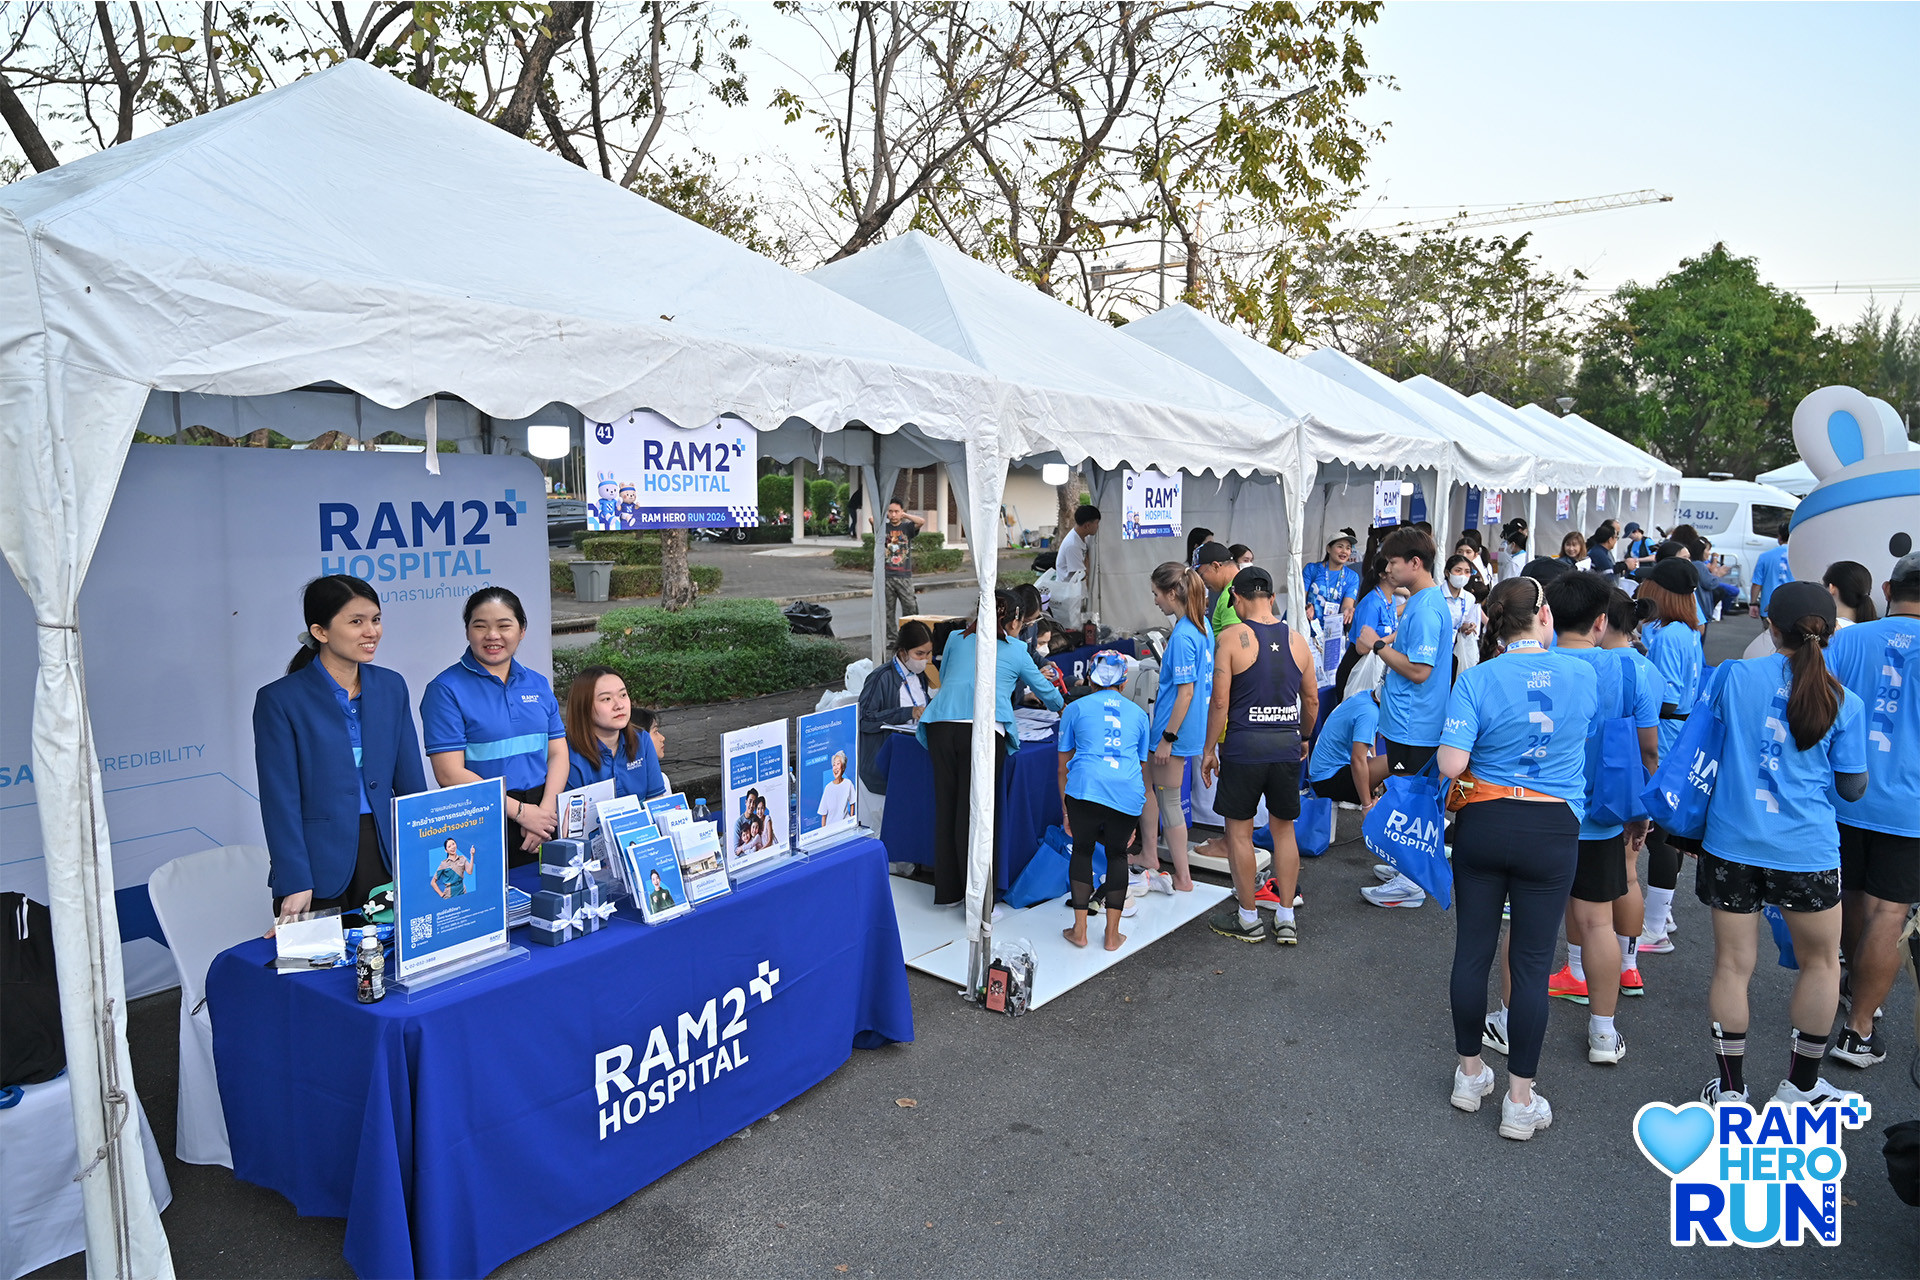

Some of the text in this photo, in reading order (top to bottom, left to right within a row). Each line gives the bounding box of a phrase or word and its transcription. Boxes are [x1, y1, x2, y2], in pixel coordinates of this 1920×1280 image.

[597, 426, 612, 438] 41
[643, 439, 730, 472] RAM2
[644, 473, 730, 492] HOSPITAL
[1145, 488, 1173, 508] RAM
[1384, 492, 1397, 506] RAM
[641, 512, 726, 523] RAM HERO RUN 2026
[1144, 510, 1172, 520] HOSPITAL
[319, 500, 490, 551] RAM2
[321, 549, 491, 582] HOSPITAL
[1887, 639, 1910, 648] RUN
[1175, 665, 1192, 673] RAM
[1527, 680, 1550, 688] RUN
[1877, 687, 1900, 700] 20
[1874, 699, 1898, 713] 26
[1249, 713, 1297, 721] COMPANY
[1445, 718, 1460, 729] AM
[1104, 728, 1121, 737] 20
[1104, 737, 1121, 746] 26
[1528, 735, 1550, 747] 20
[1760, 740, 1783, 757] 20
[100, 744, 206, 772] REDIBILITY
[1760, 754, 1779, 771] 26
[1386, 809, 1439, 848] RAM
[1383, 827, 1436, 858] HOSPITAL
[1374, 845, 1397, 866] 1512
[595, 987, 747, 1105] RAM2
[599, 1038, 749, 1140] HOSPITAL
